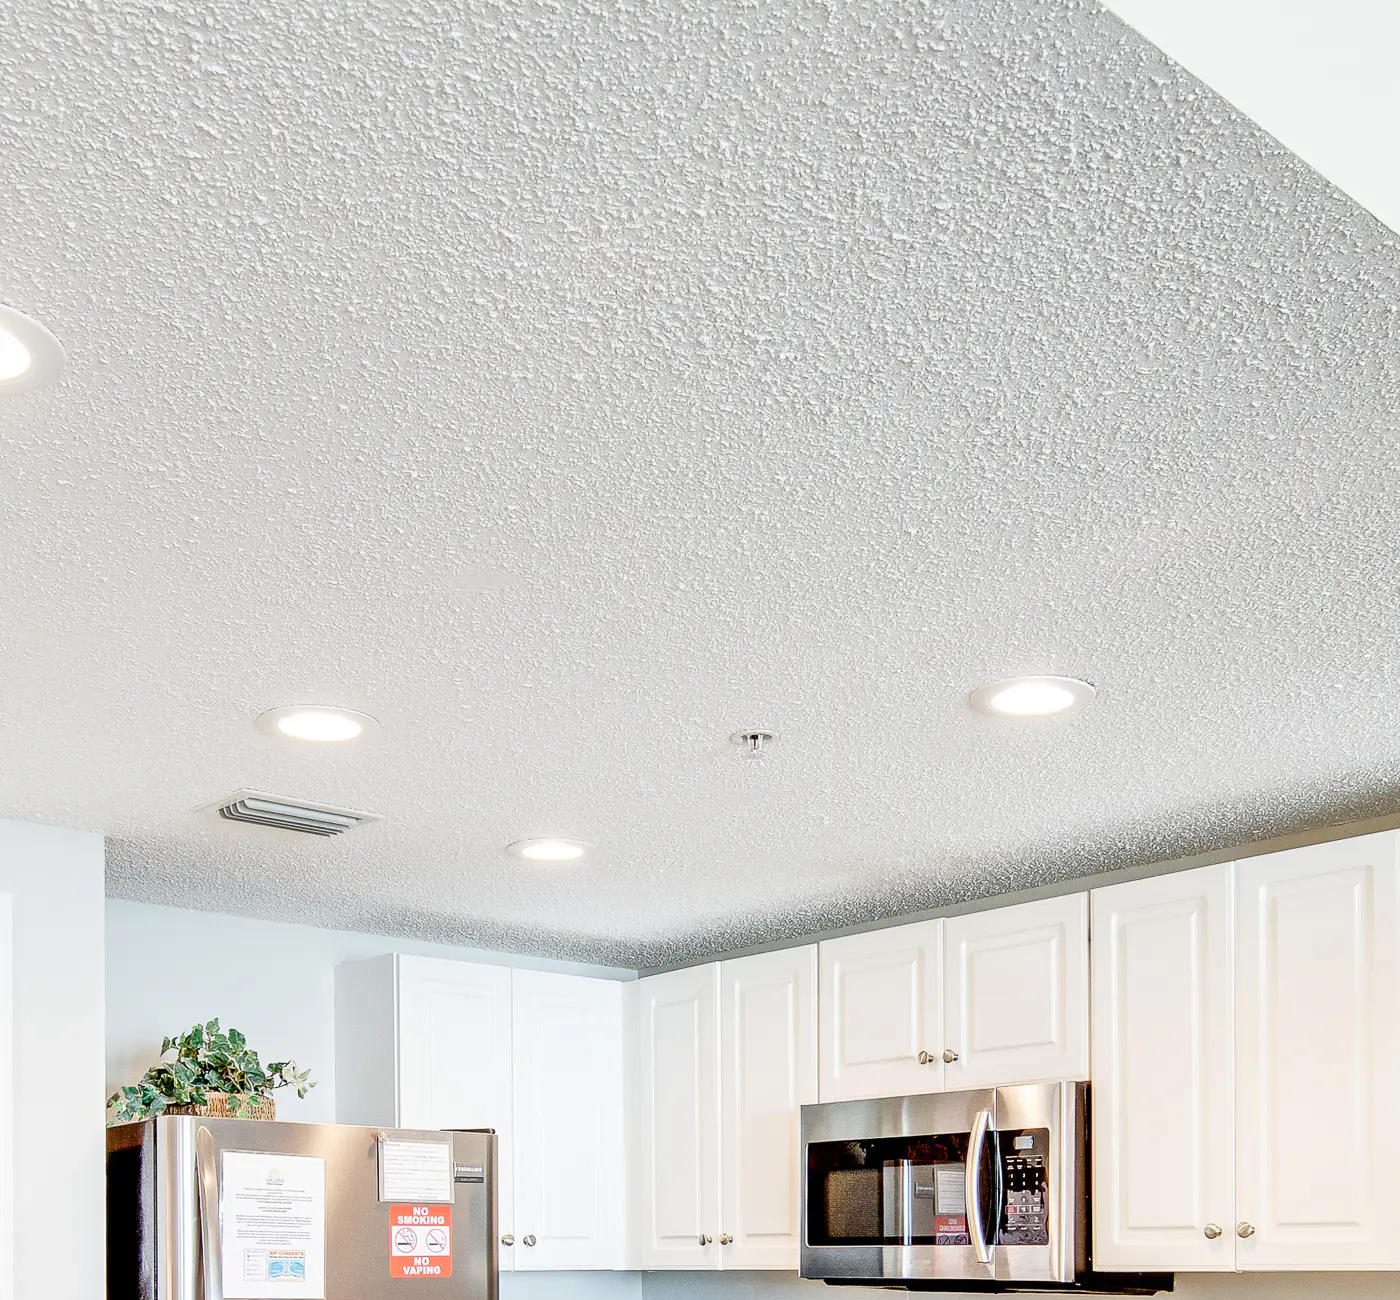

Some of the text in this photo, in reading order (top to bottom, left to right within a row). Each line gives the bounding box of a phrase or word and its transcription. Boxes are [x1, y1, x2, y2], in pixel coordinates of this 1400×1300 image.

[413, 1207, 429, 1216] NO
[397, 1216, 445, 1225] SMOKING
[414, 1257, 429, 1266] NO
[403, 1266, 441, 1275] VAPING
